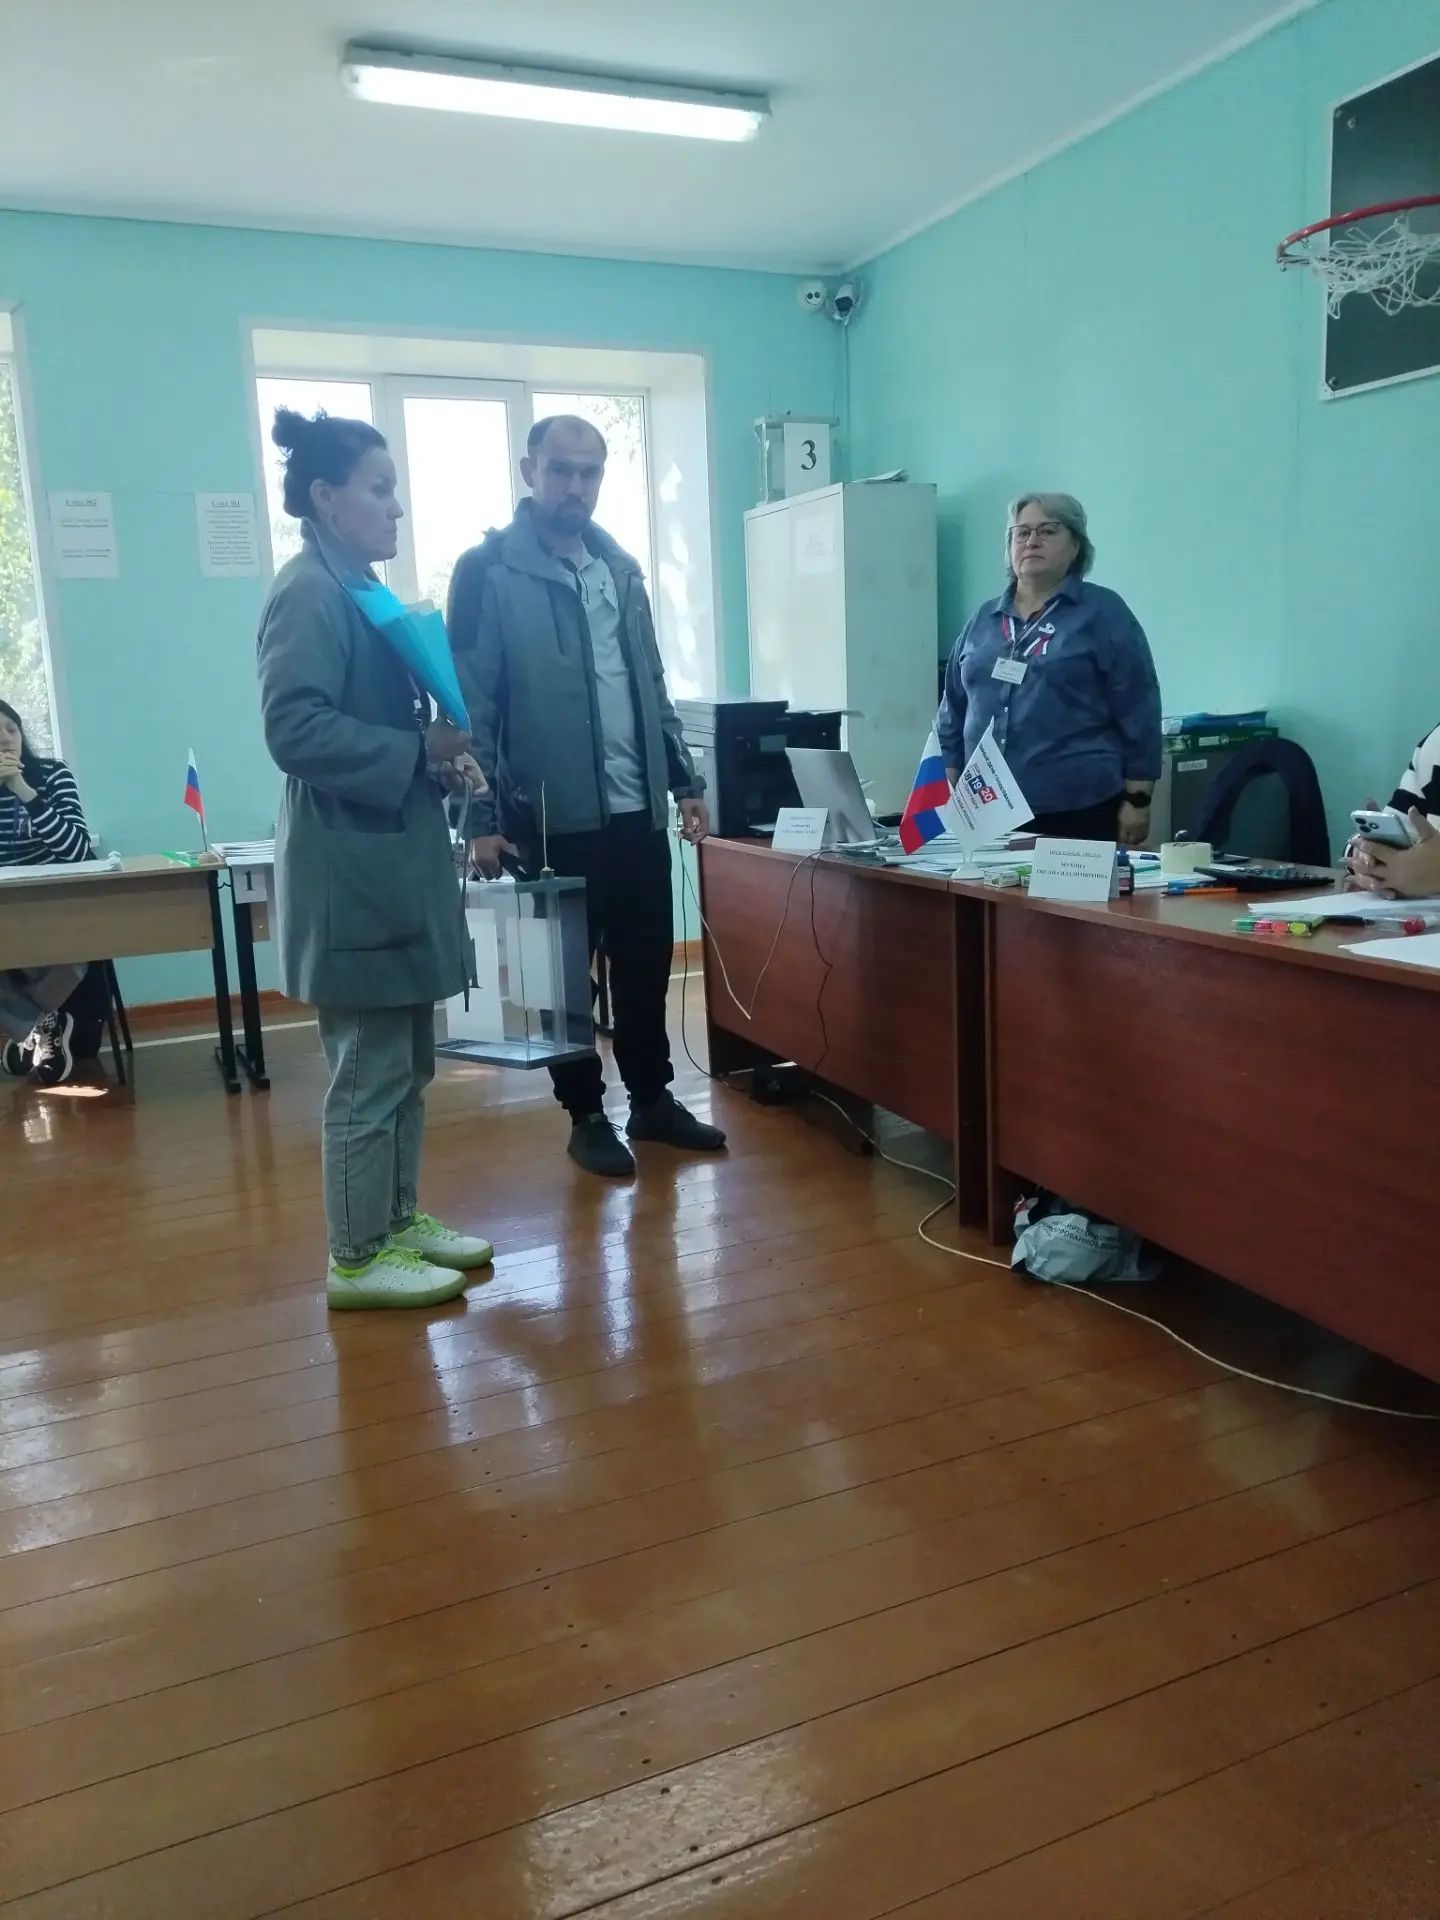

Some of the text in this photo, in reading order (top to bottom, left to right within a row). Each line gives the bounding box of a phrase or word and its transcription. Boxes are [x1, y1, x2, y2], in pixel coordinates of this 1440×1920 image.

[801, 439, 817, 471] 3
[987, 760, 996, 775] ДЕНЬ
[964, 769, 994, 802] 18 19 20
[243, 870, 255, 891] 1
